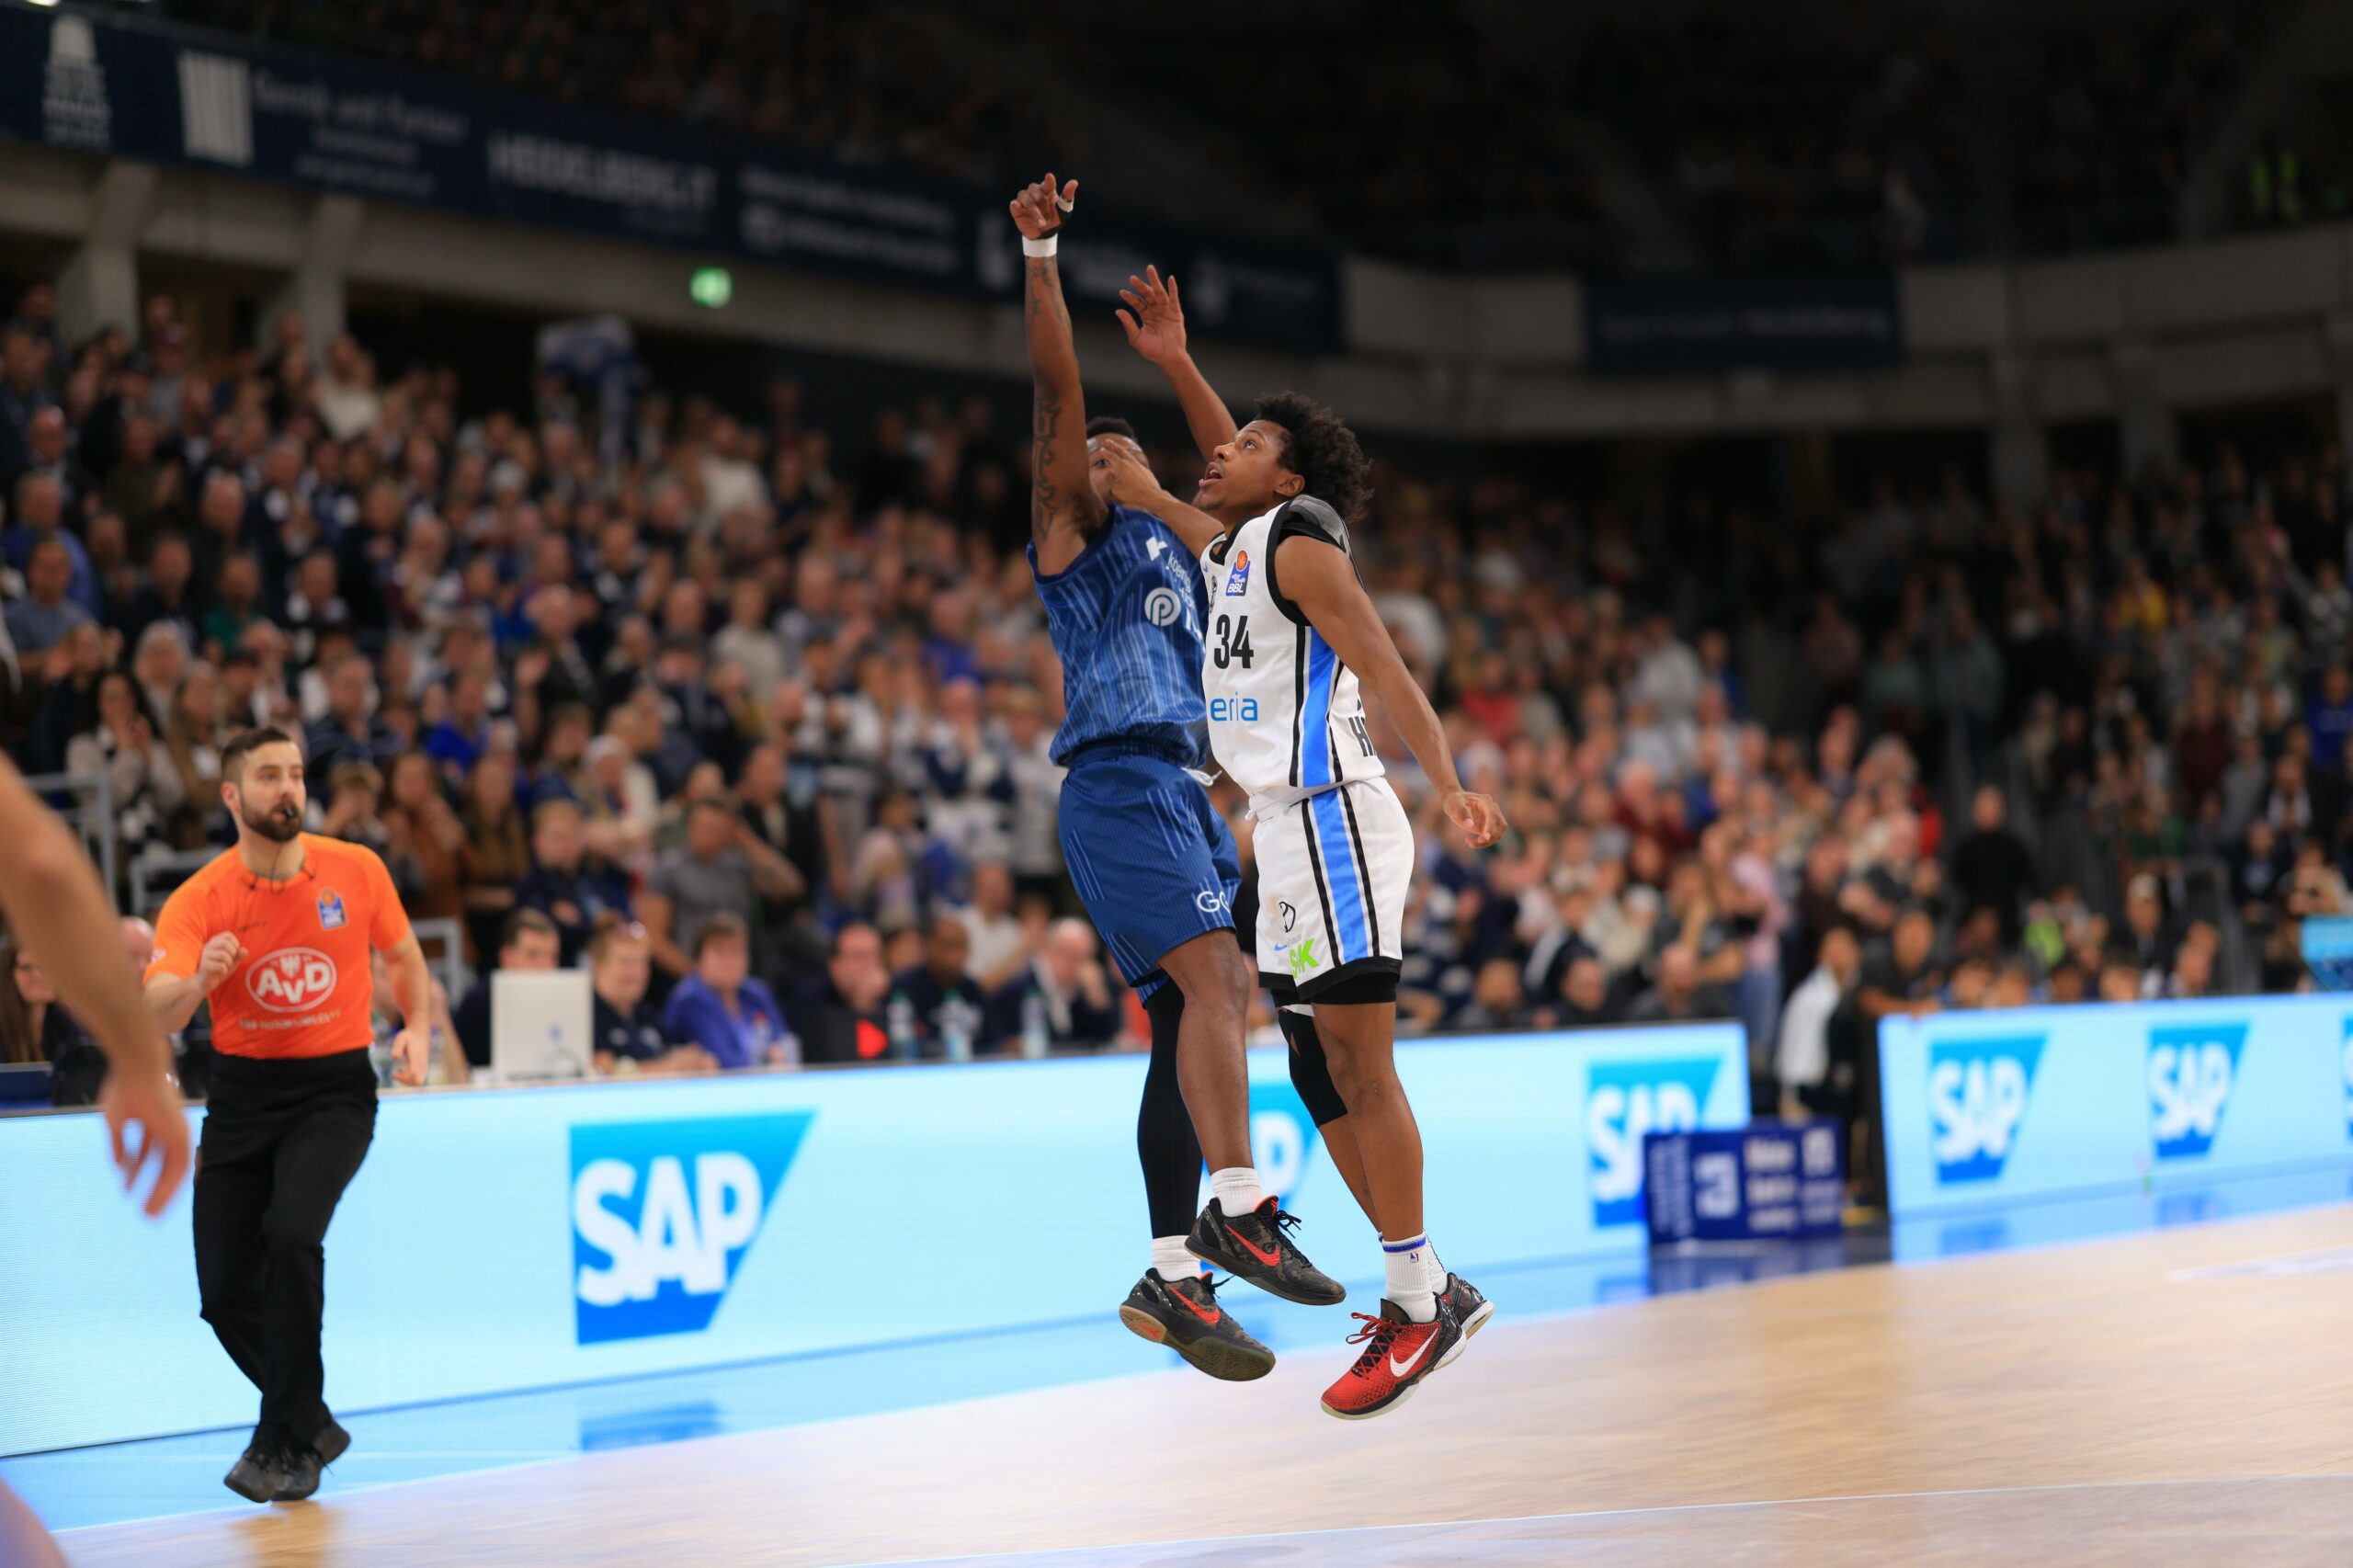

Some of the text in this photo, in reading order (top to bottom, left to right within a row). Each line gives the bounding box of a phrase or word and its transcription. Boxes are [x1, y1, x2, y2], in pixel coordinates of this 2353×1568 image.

[1227, 583, 1244, 594] BBL
[1213, 614, 1254, 669] 34
[1210, 691, 1258, 722] eria
[1933, 1057, 2026, 1162] SAP
[2151, 1042, 2232, 1139] SAP
[574, 1151, 763, 1307] SAP
